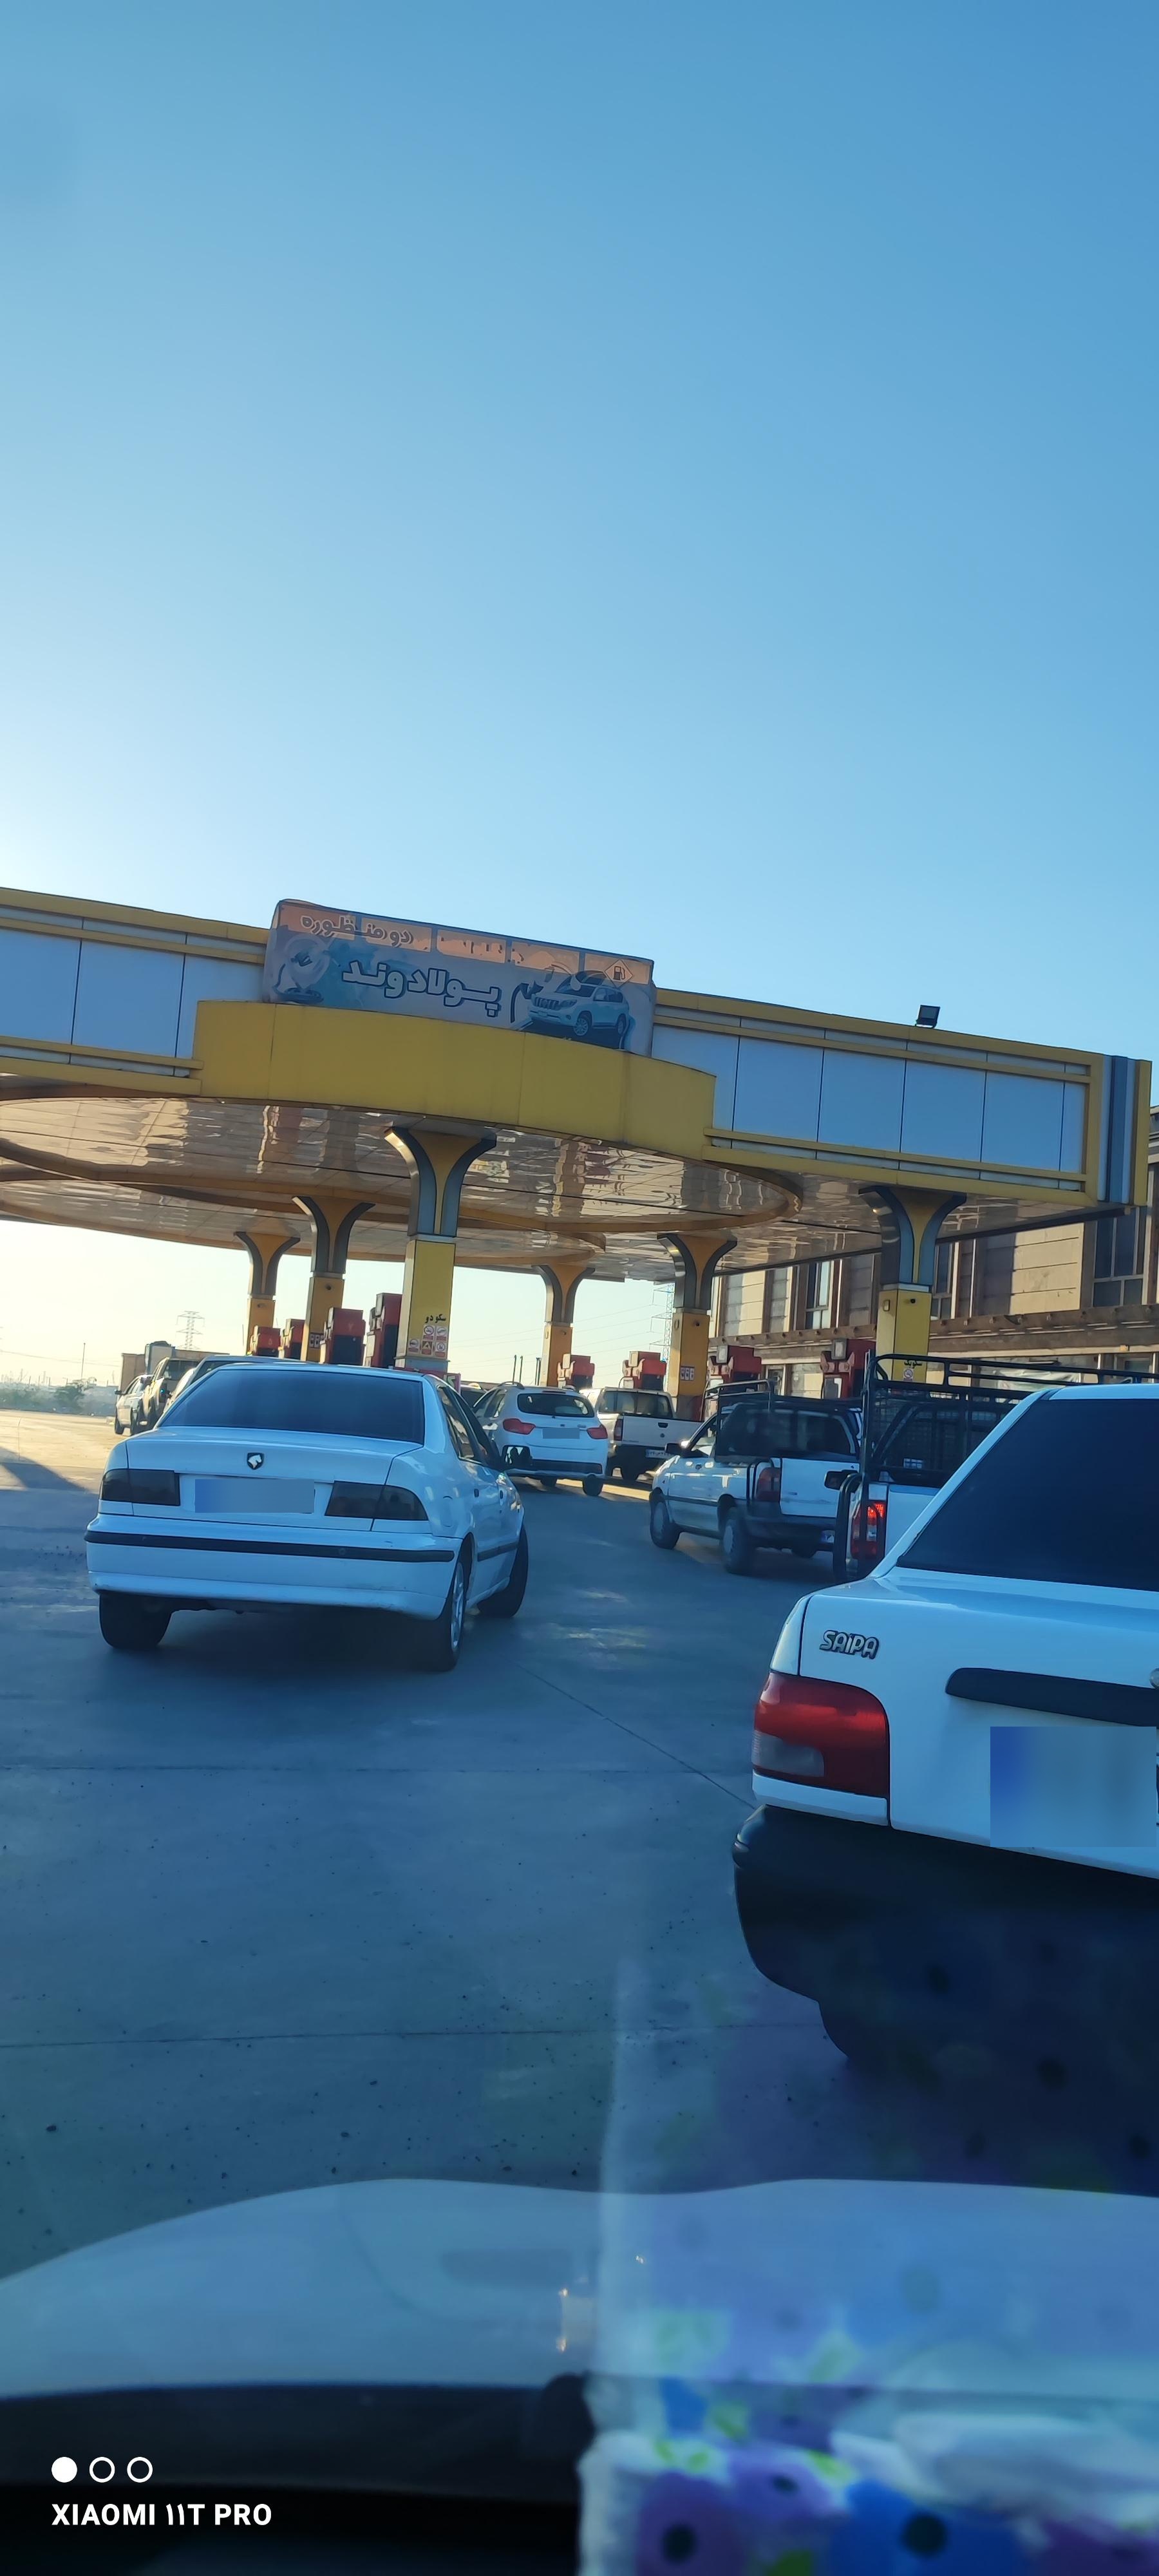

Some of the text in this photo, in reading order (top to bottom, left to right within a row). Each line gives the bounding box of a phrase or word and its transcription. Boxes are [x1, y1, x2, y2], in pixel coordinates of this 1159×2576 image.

[389, 929, 413, 948] دو
[342, 960, 502, 1018] پولادوند
[819, 1630, 880, 1660] SAIPA
